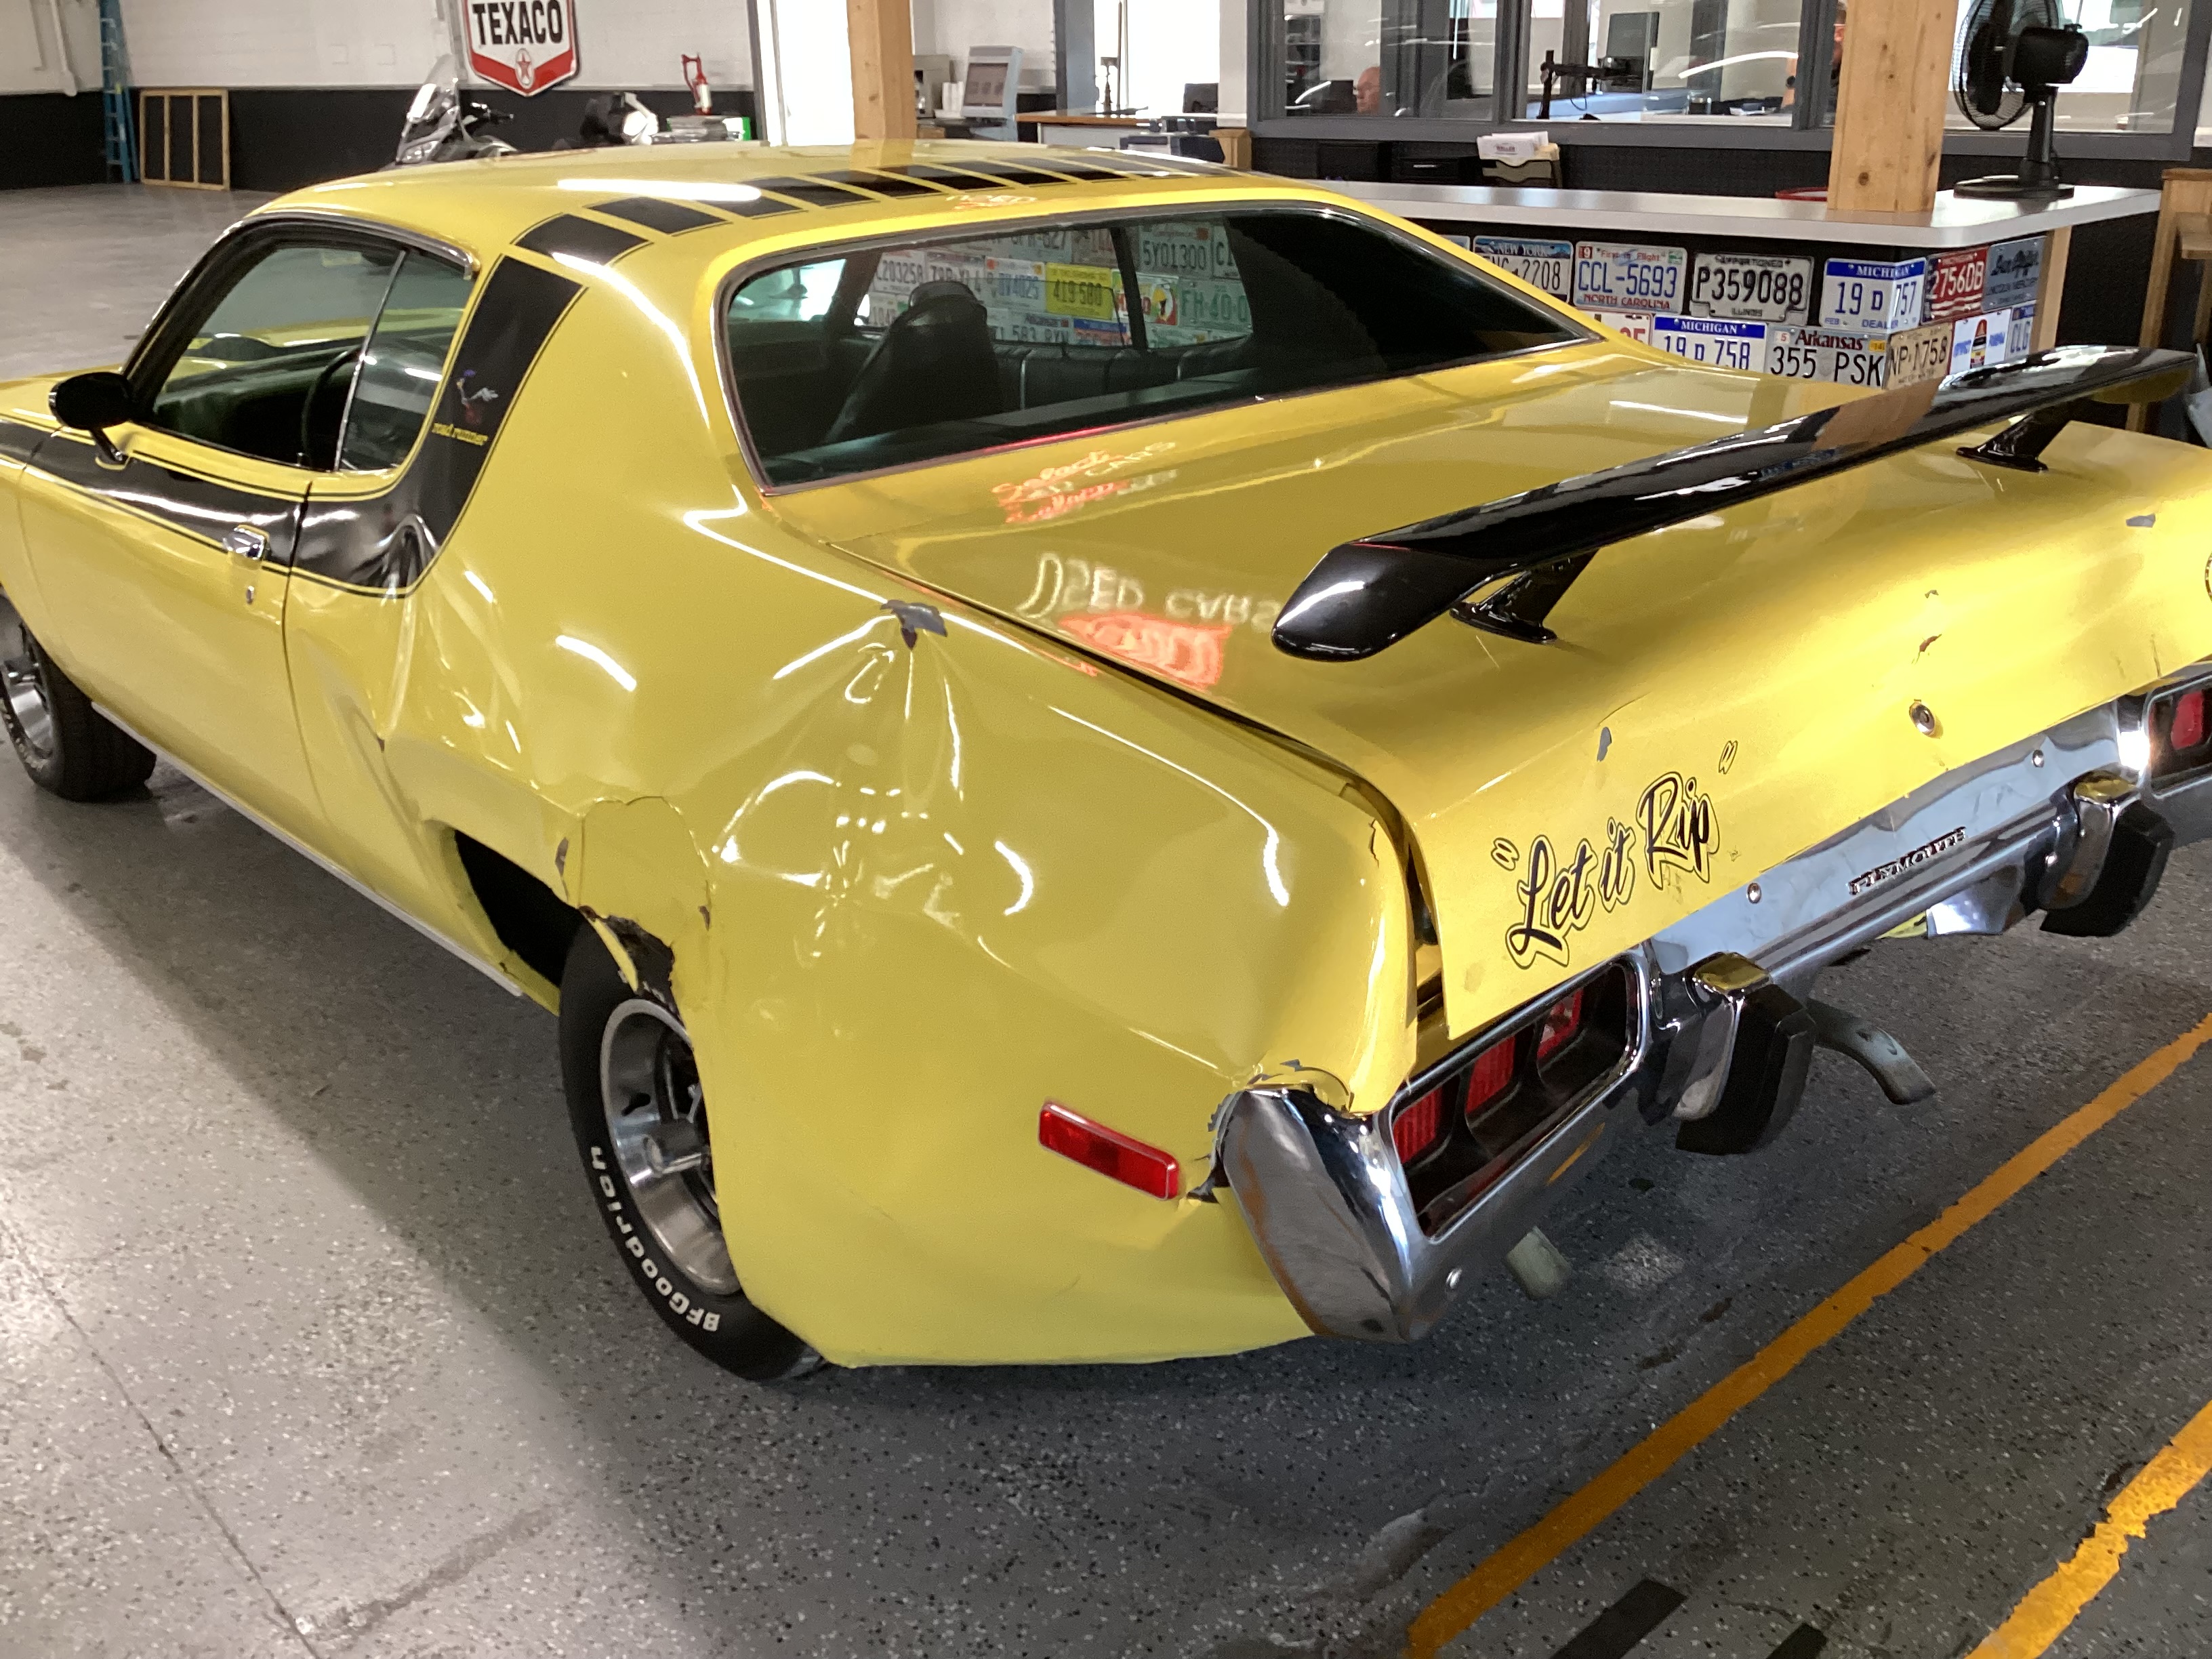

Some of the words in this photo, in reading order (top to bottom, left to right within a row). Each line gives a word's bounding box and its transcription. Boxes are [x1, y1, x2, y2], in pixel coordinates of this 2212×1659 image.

[472, 0, 562, 45] TEXACO
[1637, 251, 1660, 262] Flight
[1856, 265, 1910, 278] MICHIGAN
[1578, 260, 1677, 298] CCL-5693
[1696, 266, 1803, 305] P359088
[1583, 293, 1618, 306] NORTH
[1621, 297, 1671, 310] CAROLINA
[1731, 307, 1763, 317] ILLINOIS
[1835, 281, 1863, 315] 19
[1871, 290, 1883, 310] D
[1681, 321, 1738, 335] MICHIGAN
[1795, 329, 1864, 351] Arkansas
[1770, 346, 1817, 379] 355
[1834, 351, 1885, 387] PSK
[1599, 816, 1636, 913] it
[1846, 826, 1967, 895] PLYMOUTH
